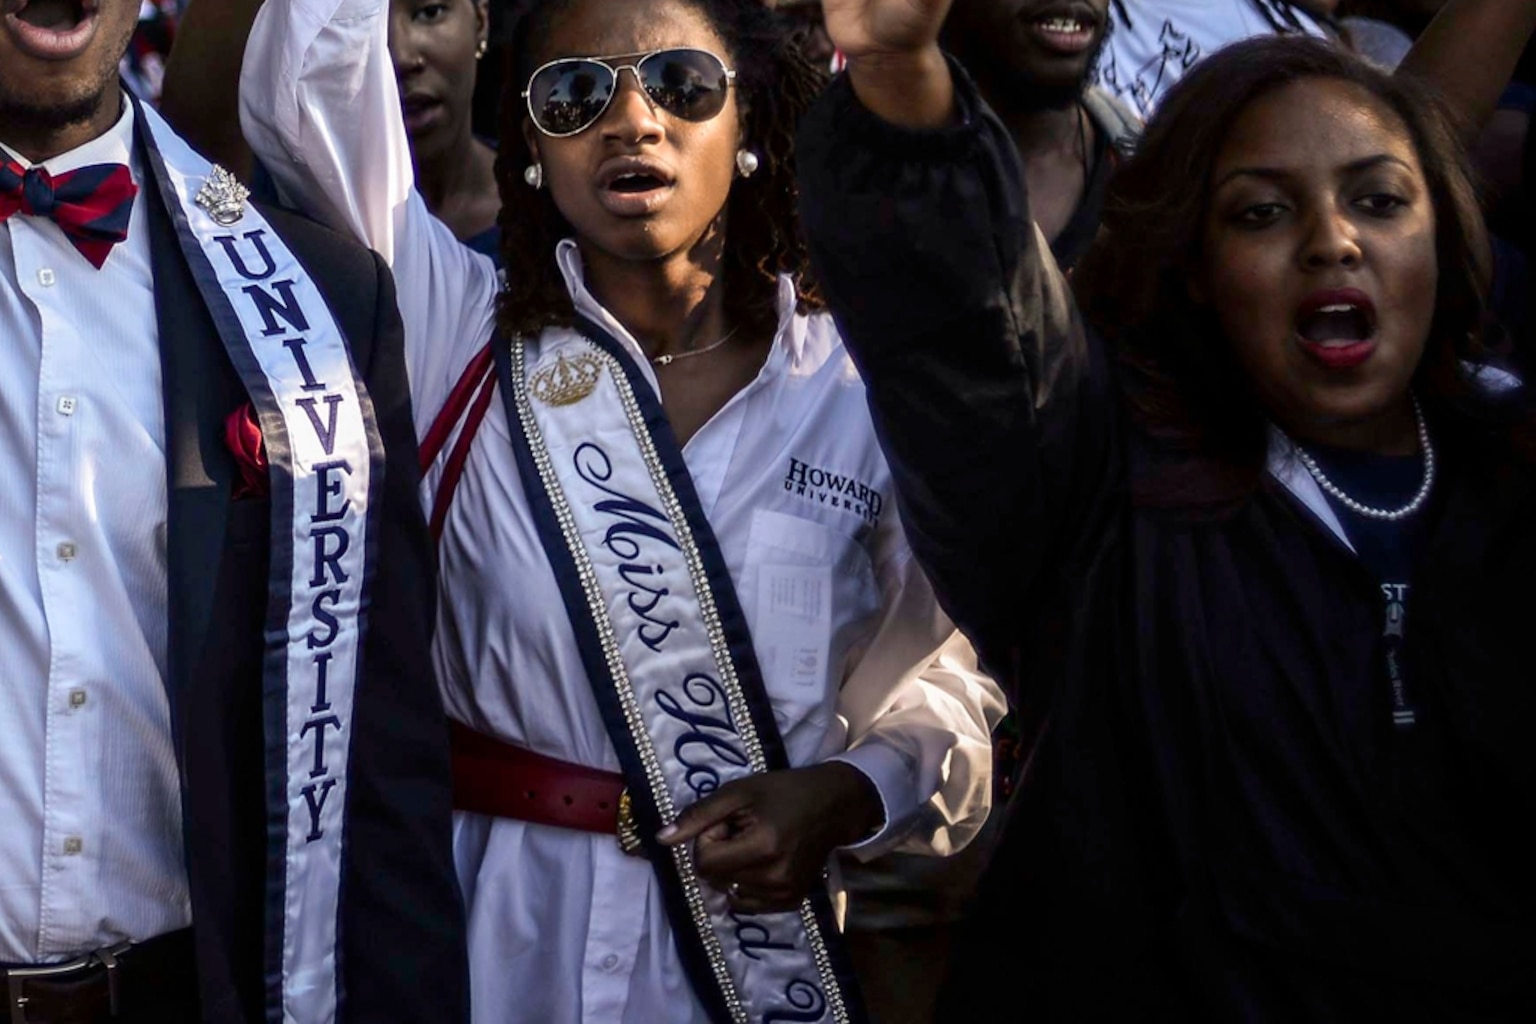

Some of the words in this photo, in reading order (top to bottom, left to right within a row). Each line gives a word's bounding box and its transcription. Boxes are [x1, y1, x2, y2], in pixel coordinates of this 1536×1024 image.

[213, 228, 354, 843] UNIVERSITY
[572, 441, 684, 654] Miss
[654, 672, 796, 962] Hod
[785, 457, 883, 517] HOWARD
